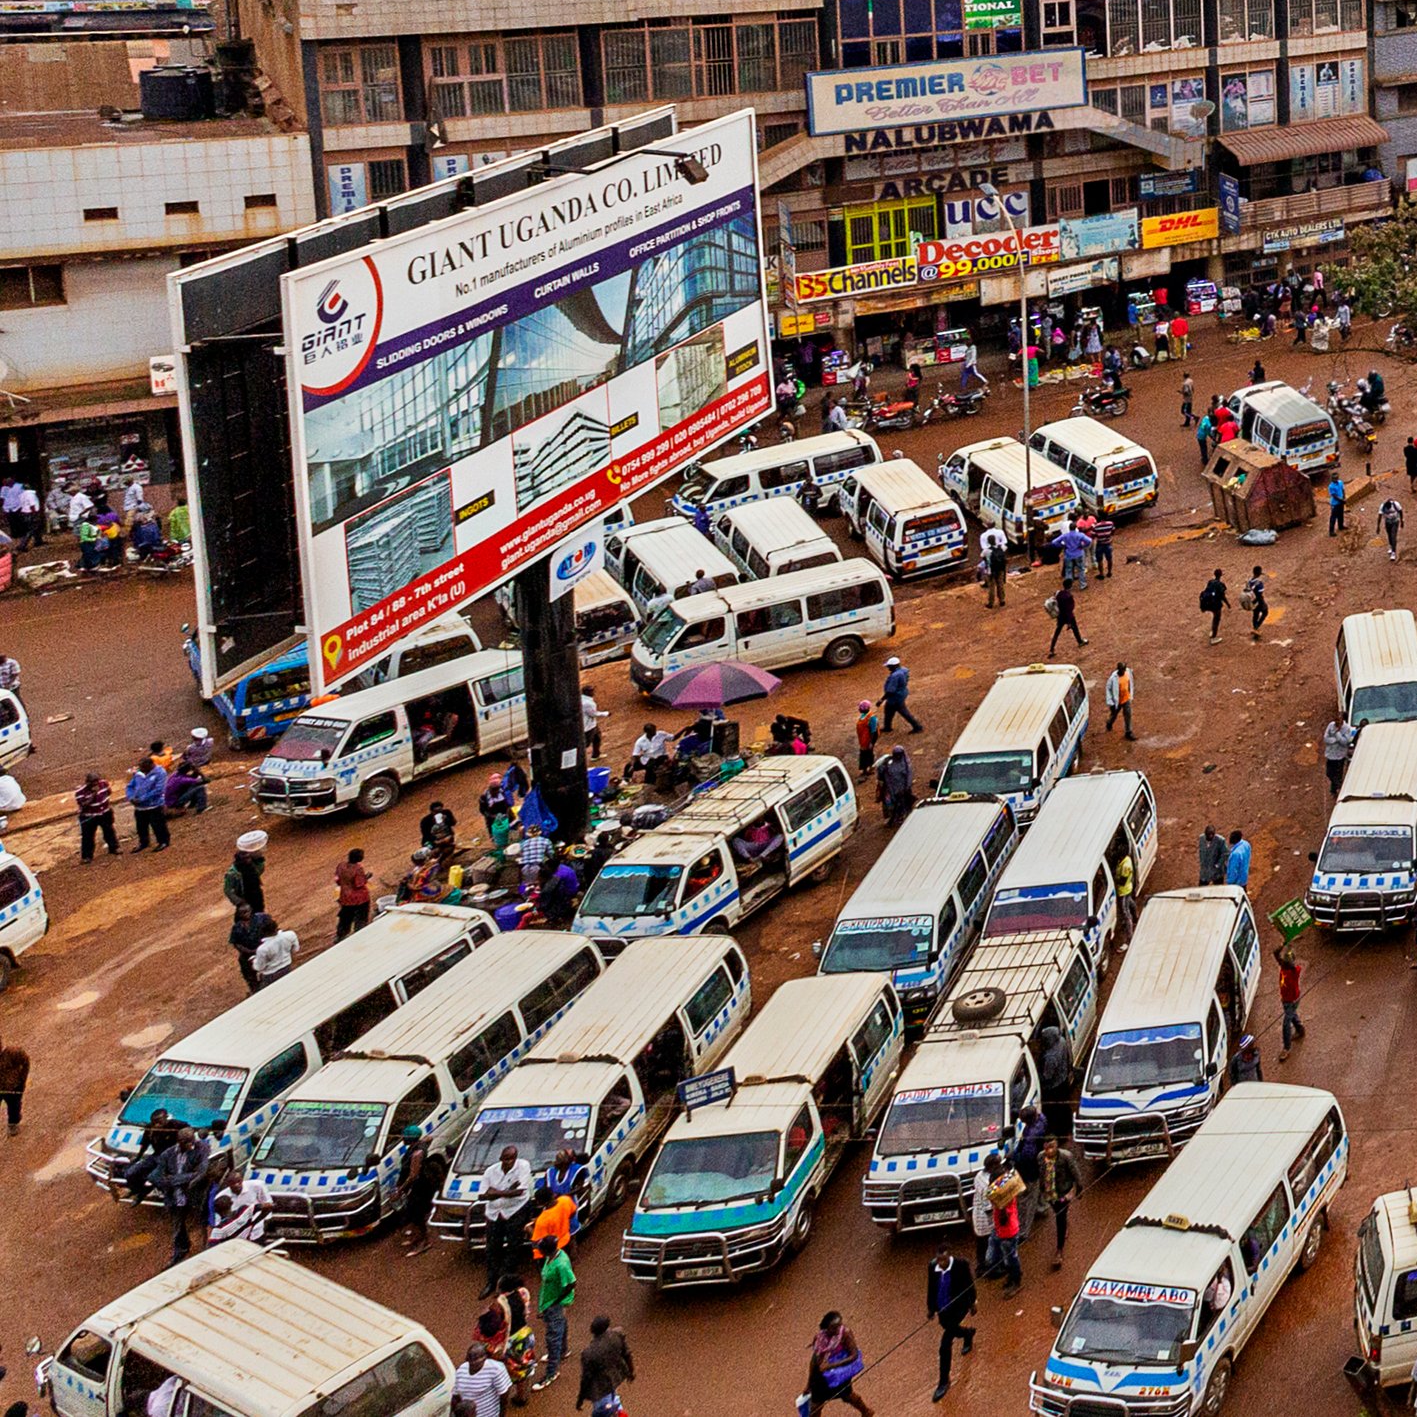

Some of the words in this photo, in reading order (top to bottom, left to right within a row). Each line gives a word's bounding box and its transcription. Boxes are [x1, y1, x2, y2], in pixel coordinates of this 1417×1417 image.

[965, 0, 1015, 12] TIONAL
[835, 72, 965, 105] PREMIER
[1011, 62, 1063, 86] BET
[865, 104, 934, 122] Better
[938, 97, 993, 115] Than
[844, 111, 1055, 153] NALUBWAMA
[878, 166, 1009, 200] ARCADE
[408, 231, 493, 286] GIANT
[498, 191, 597, 250] UGANDA
[602, 177, 638, 209] CO.
[643, 142, 723, 194] LIMED
[629, 237, 656, 258] OFFICE
[656, 222, 692, 248] PARTITION
[698, 210, 715, 229] SHOP
[715, 200, 742, 221] FRONTS
[1158, 214, 1203, 233] DHL
[455, 277, 478, 299] No.1
[480, 252, 546, 289] manufacturers
[547, 245, 557, 258] of
[559, 227, 603, 255] Aluminium
[604, 215, 634, 238] profiles
[644, 201, 661, 218] East
[661, 191, 683, 212] Africa
[918, 229, 1059, 265] Decoder
[1280, 227, 1298, 239] AUTO
[1031, 247, 1059, 257] Shop
[534, 277, 571, 299] CURTAIN
[569, 262, 600, 286] WALLS
[828, 262, 916, 294] Channels
[376, 341, 422, 370] SLIDDING
[422, 328, 456, 350] DOORS
[465, 304, 509, 332] WINDOWS
[611, 415, 637, 437] BILLETS
[620, 480, 630, 493] No
[630, 468, 650, 487] More
[693, 437, 705, 455] buy
[621, 459, 640, 477] 0754
[641, 450, 657, 467] 999
[657, 441, 670, 458] 299
[459, 497, 489, 520] INGOTS
[499, 488, 596, 555] www.giantuganda.co.ug
[501, 499, 602, 570] giant.uganda@gmail.com
[346, 621, 369, 641] Plot
[370, 612, 385, 627] 84
[392, 597, 406, 613] 88
[413, 583, 432, 602] 7th
[433, 562, 465, 588] street
[347, 618, 400, 661] industrial
[401, 608, 426, 627] area
[427, 591, 448, 613] K'la
[449, 581, 466, 602] (U)
[899, 1088, 933, 1103] DADDY
[940, 1083, 992, 1097] MATHIAS
[1160, 1287, 1188, 1302] ABO
